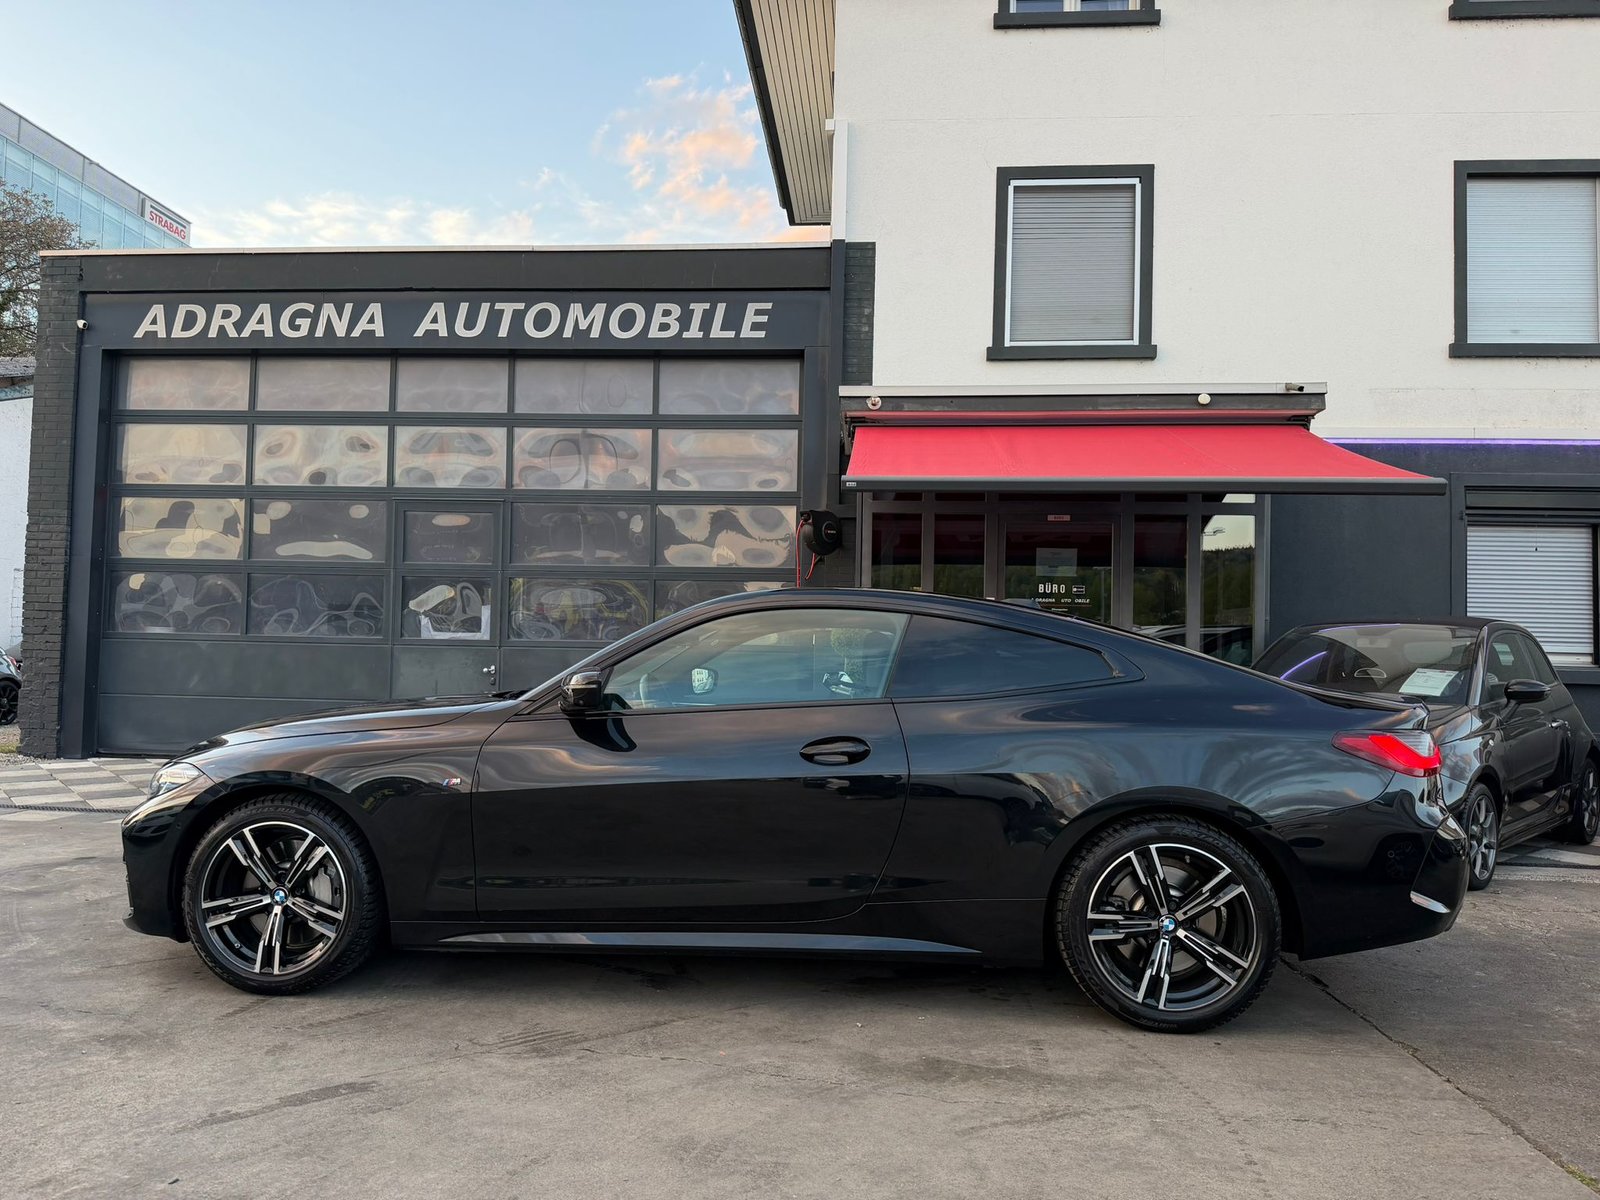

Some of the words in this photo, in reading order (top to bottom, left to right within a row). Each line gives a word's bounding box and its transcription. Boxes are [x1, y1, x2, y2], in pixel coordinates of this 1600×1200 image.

[149, 210, 186, 240] STRABAG
[133, 302, 385, 339] ADRAGNA
[413, 302, 773, 339] AUTOMOBILE
[1038, 582, 1066, 594] BÜRO
